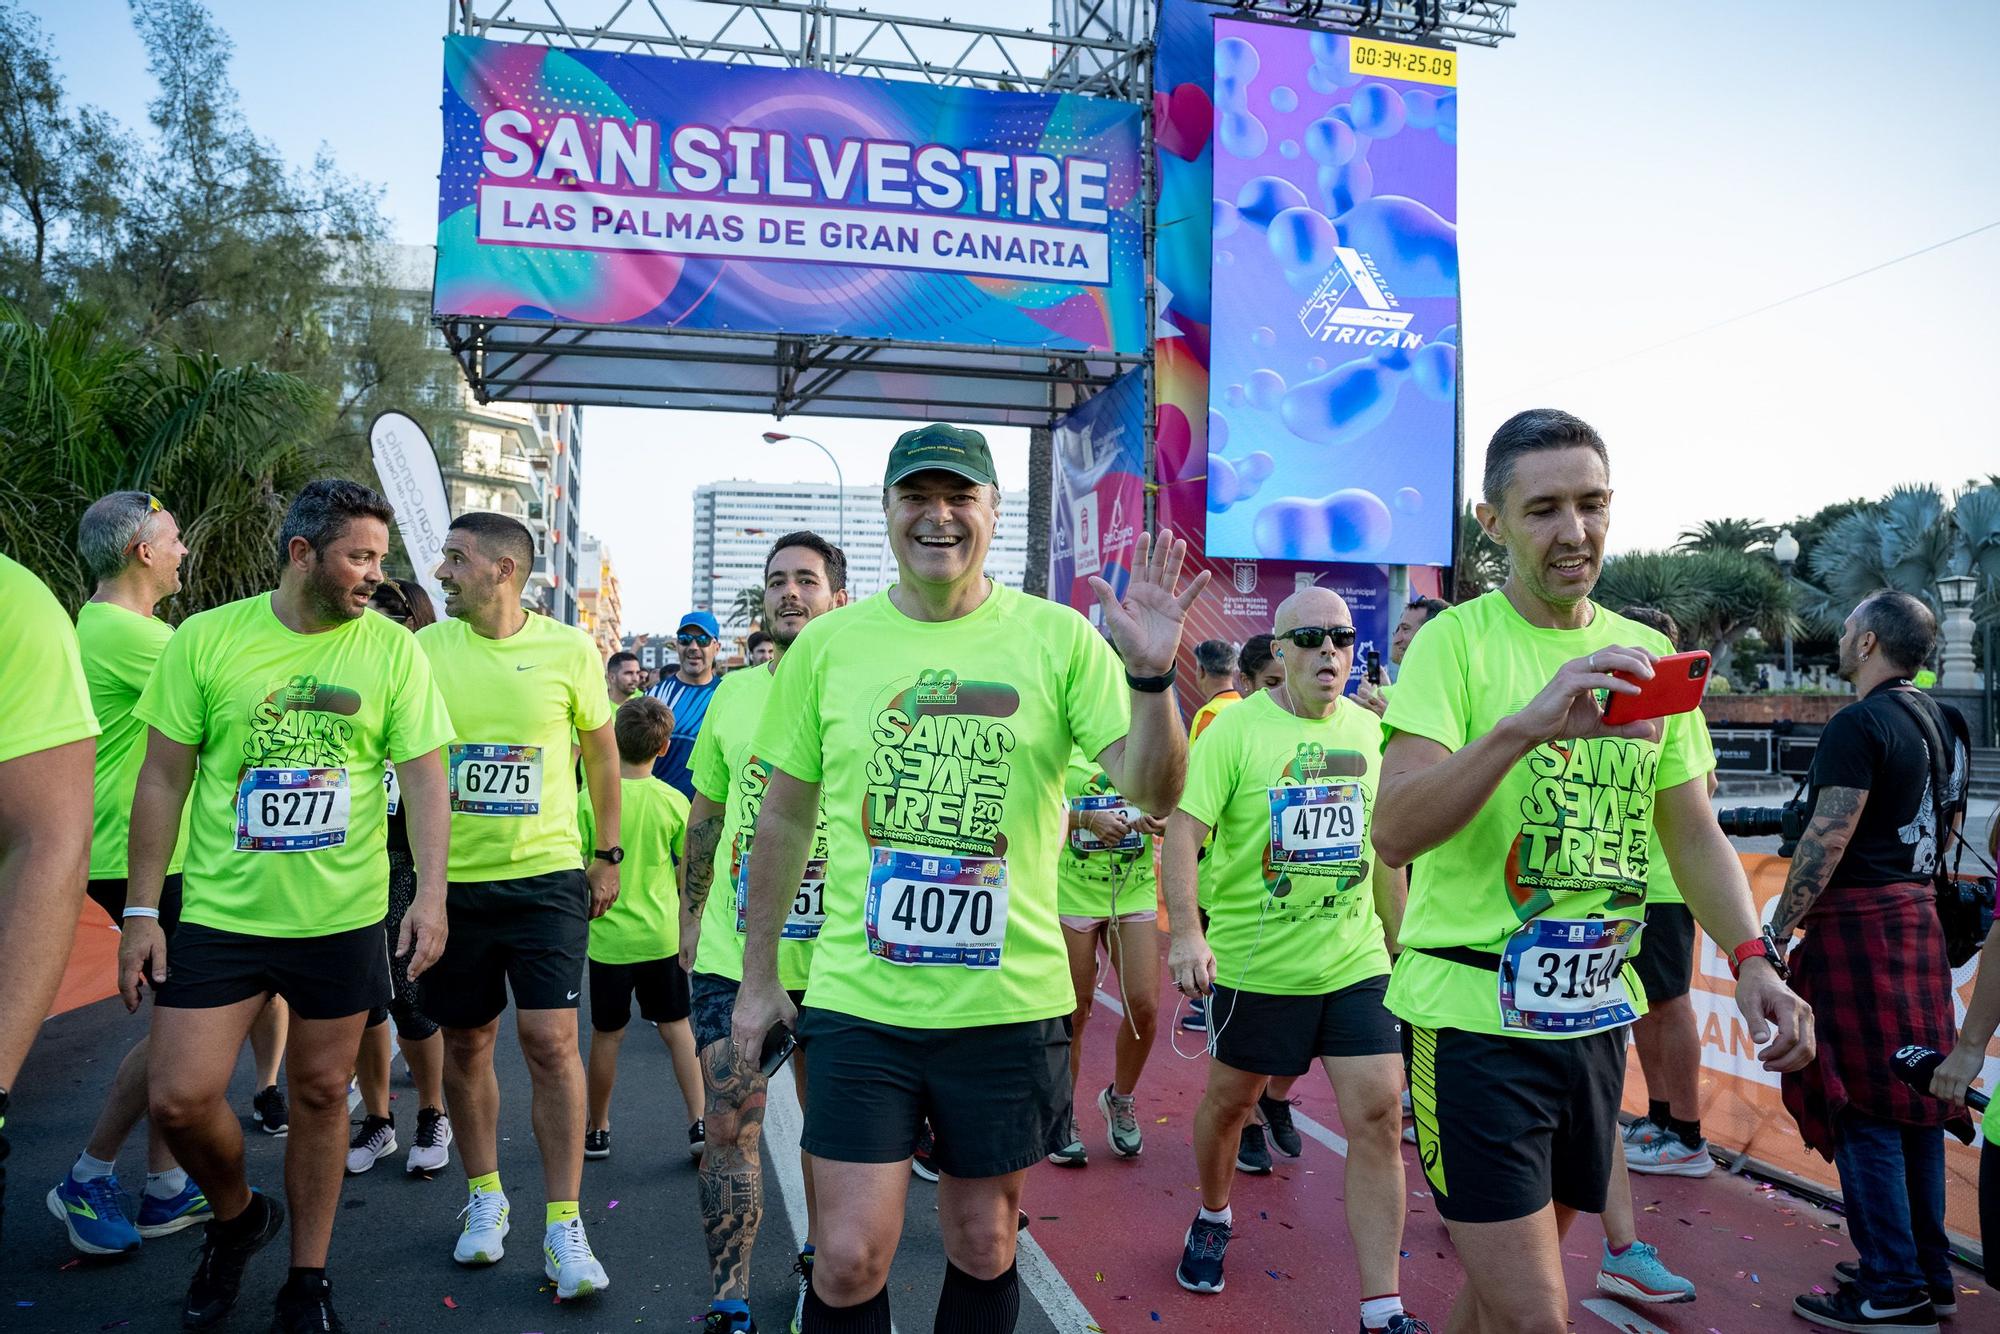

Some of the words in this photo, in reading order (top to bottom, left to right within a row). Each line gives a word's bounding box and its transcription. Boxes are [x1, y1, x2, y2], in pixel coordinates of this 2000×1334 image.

[1356, 46, 1452, 76] 00:34:25.09
[482, 109, 653, 187] SAN
[672, 127, 1108, 225] SILVESTRE
[503, 200, 577, 231] LAS
[591, 206, 744, 242] PALMAS
[759, 218, 806, 246] DE
[820, 221, 919, 254] GRAN
[933, 230, 1090, 269] CANARIA
[1360, 252, 1400, 307] TRIATLON
[1320, 325, 1423, 349] TRICAN
[1345, 587, 1376, 596] Municipal
[466, 763, 530, 795] 6275
[261, 790, 335, 827] 6277
[1292, 805, 1355, 840] 4729
[884, 830, 914, 843] PALMAS
[915, 835, 927, 844] DE
[928, 837, 953, 848] GRAN
[953, 839, 995, 855] CANARIA
[960, 866, 982, 875] HPS
[891, 884, 993, 936] 4070
[1533, 949, 1617, 998] 3154
